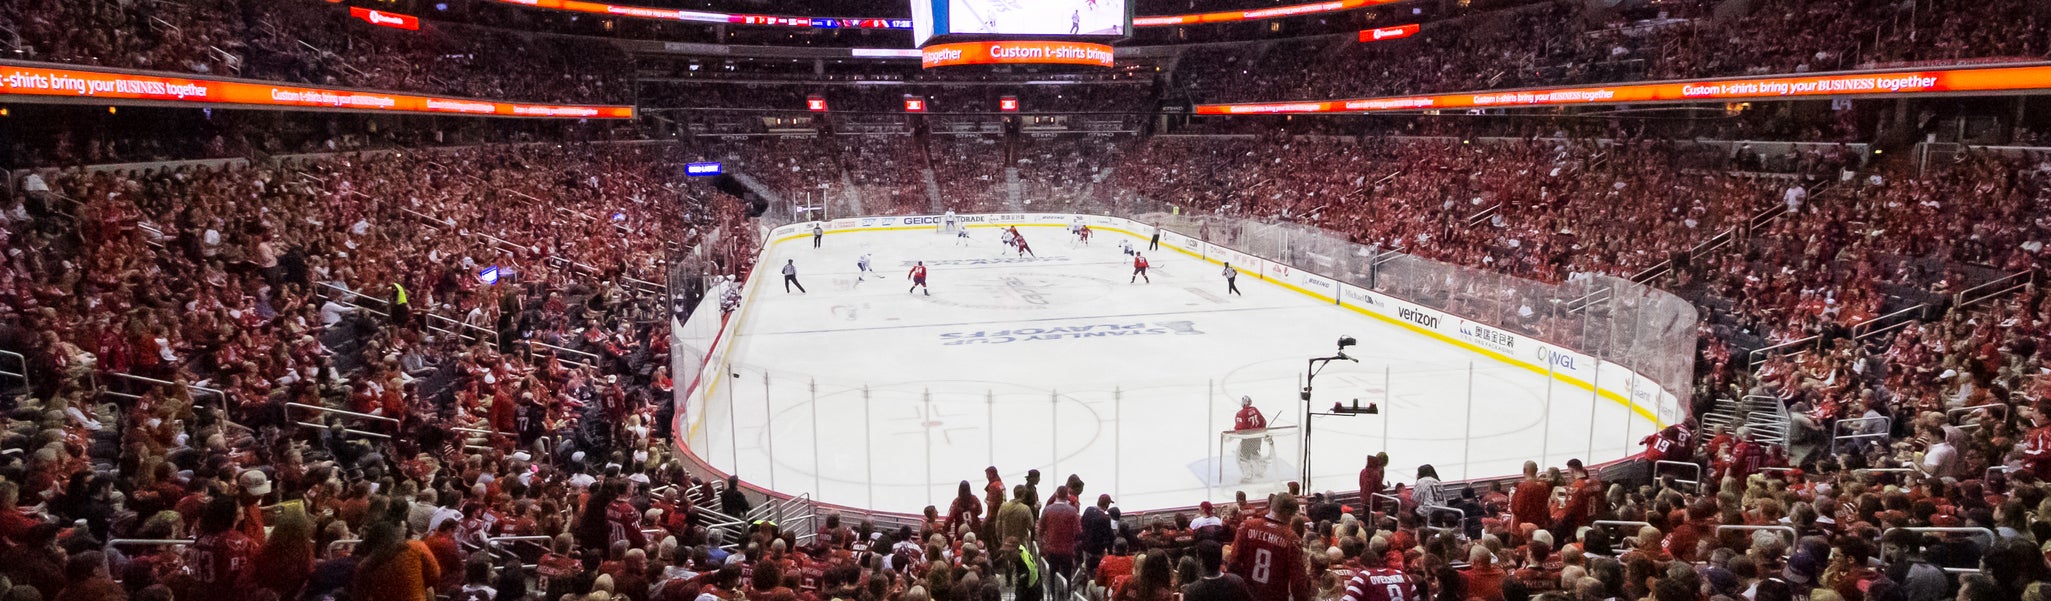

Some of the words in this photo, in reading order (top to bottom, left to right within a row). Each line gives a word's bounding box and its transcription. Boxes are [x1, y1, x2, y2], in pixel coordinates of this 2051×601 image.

[929, 48, 962, 63] together
[990, 45, 1043, 58] Custom
[1045, 46, 1085, 58] t-shirts
[1086, 47, 1106, 62] bring
[50, 73, 86, 94] bring
[87, 79, 115, 95] your
[116, 79, 166, 95] BUSINESS
[166, 82, 207, 99] together
[1682, 83, 1719, 97] Custom
[1721, 82, 1758, 95] t-shirts
[1759, 80, 1789, 96] bring
[1790, 82, 1818, 96] your
[1818, 77, 1875, 91] BUSINESS
[1876, 75, 1937, 90] together
[1474, 94, 1496, 104] Custom
[1496, 93, 1517, 103] t-shirts
[1518, 93, 1534, 104] bring
[1535, 93, 1550, 103] your
[1550, 91, 1581, 101] BUSINESS
[1582, 89, 1614, 102] together
[956, 215, 985, 223] TORADE
[1308, 277, 1330, 289] BOEING
[1398, 305, 1438, 329] verizon
[939, 322, 1146, 340] PLAYOFFS
[1023, 327, 1167, 342] STANLEY
[942, 336, 1018, 346] CUP
[1549, 349, 1577, 371] WGL
[1653, 437, 1670, 453] 19
[1247, 528, 1289, 549] OVECHKIN
[1251, 548, 1272, 584] 8
[1369, 574, 1405, 585] OVECHKIN
